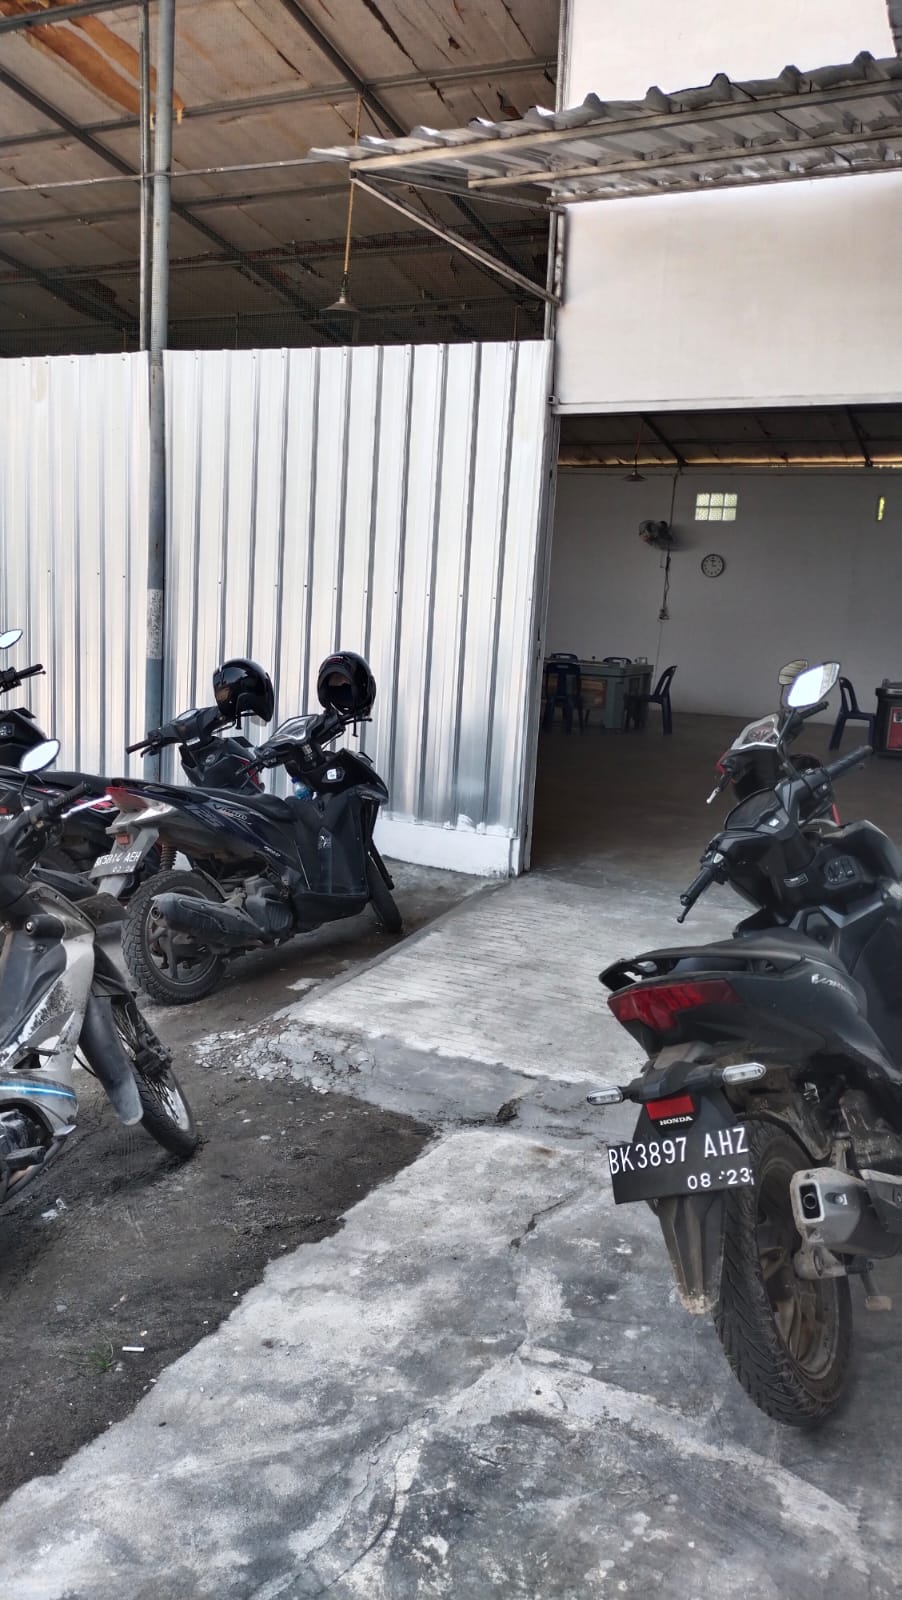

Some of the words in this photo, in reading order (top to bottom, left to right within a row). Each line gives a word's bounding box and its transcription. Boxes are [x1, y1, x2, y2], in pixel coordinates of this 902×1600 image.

[659, 1116, 693, 1126] HONDA
[704, 1127, 749, 1158] AHZ
[687, 1173, 711, 1190] 08
